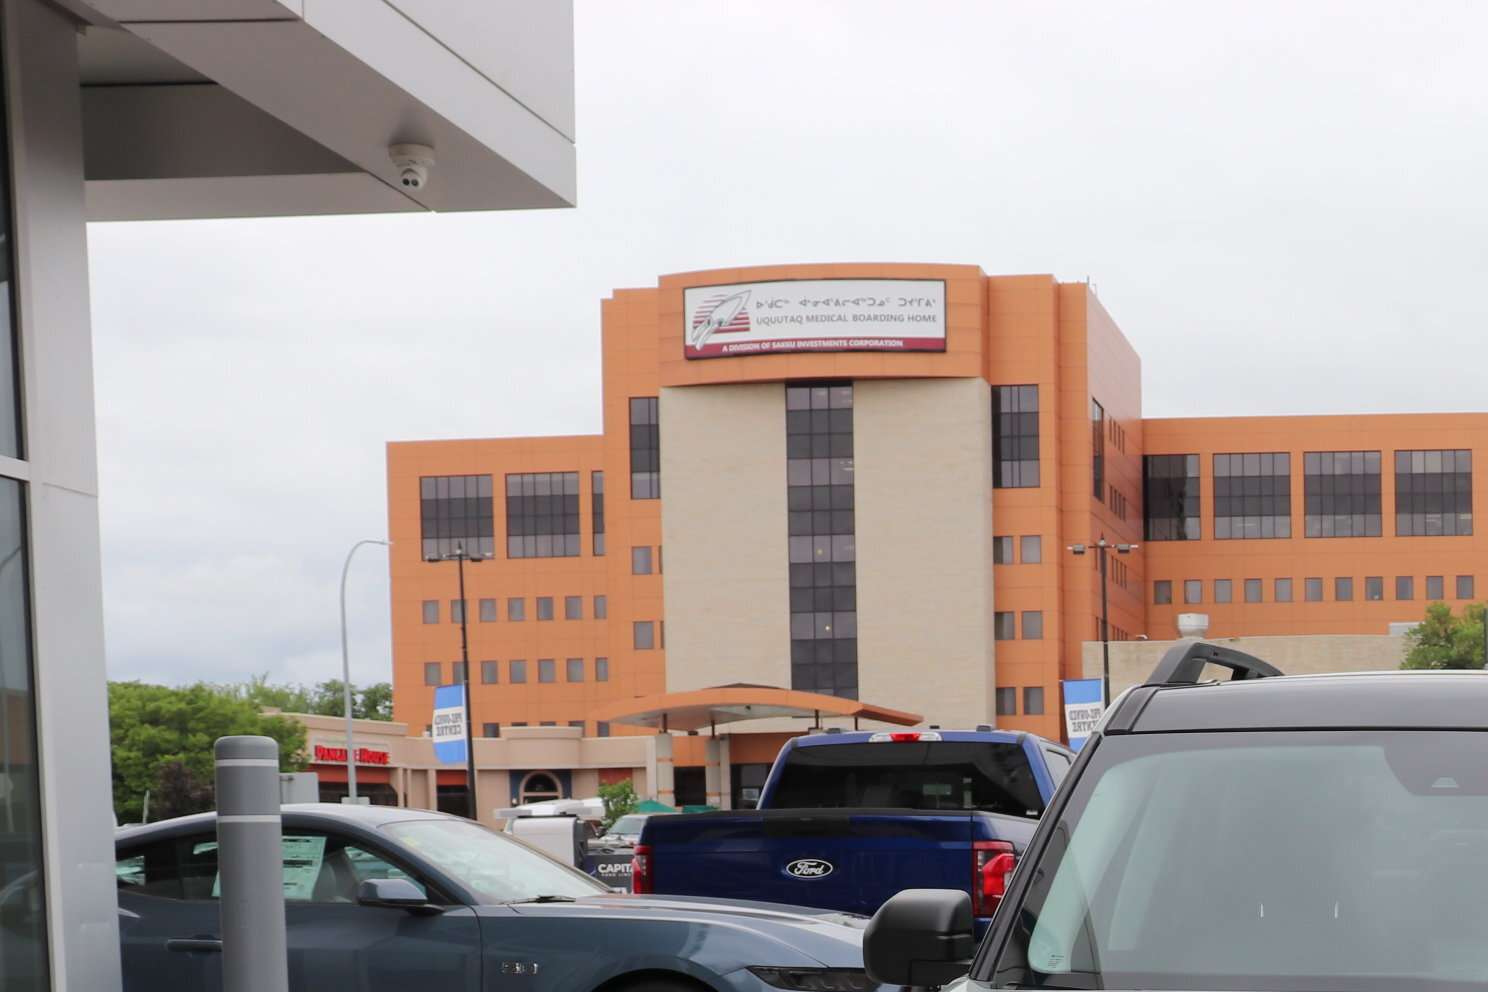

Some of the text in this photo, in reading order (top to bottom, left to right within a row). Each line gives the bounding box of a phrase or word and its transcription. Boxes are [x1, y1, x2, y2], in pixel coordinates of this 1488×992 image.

[756, 313, 937, 326] UQUUTAQ MEDICAL BOARDING HOME
[729, 343, 761, 352] DIVISION
[761, 342, 771, 350] OF
[797, 340, 848, 349] INVESTMENTS
[849, 339, 904, 348] CORPORATION
[794, 861, 825, 875] Ford
